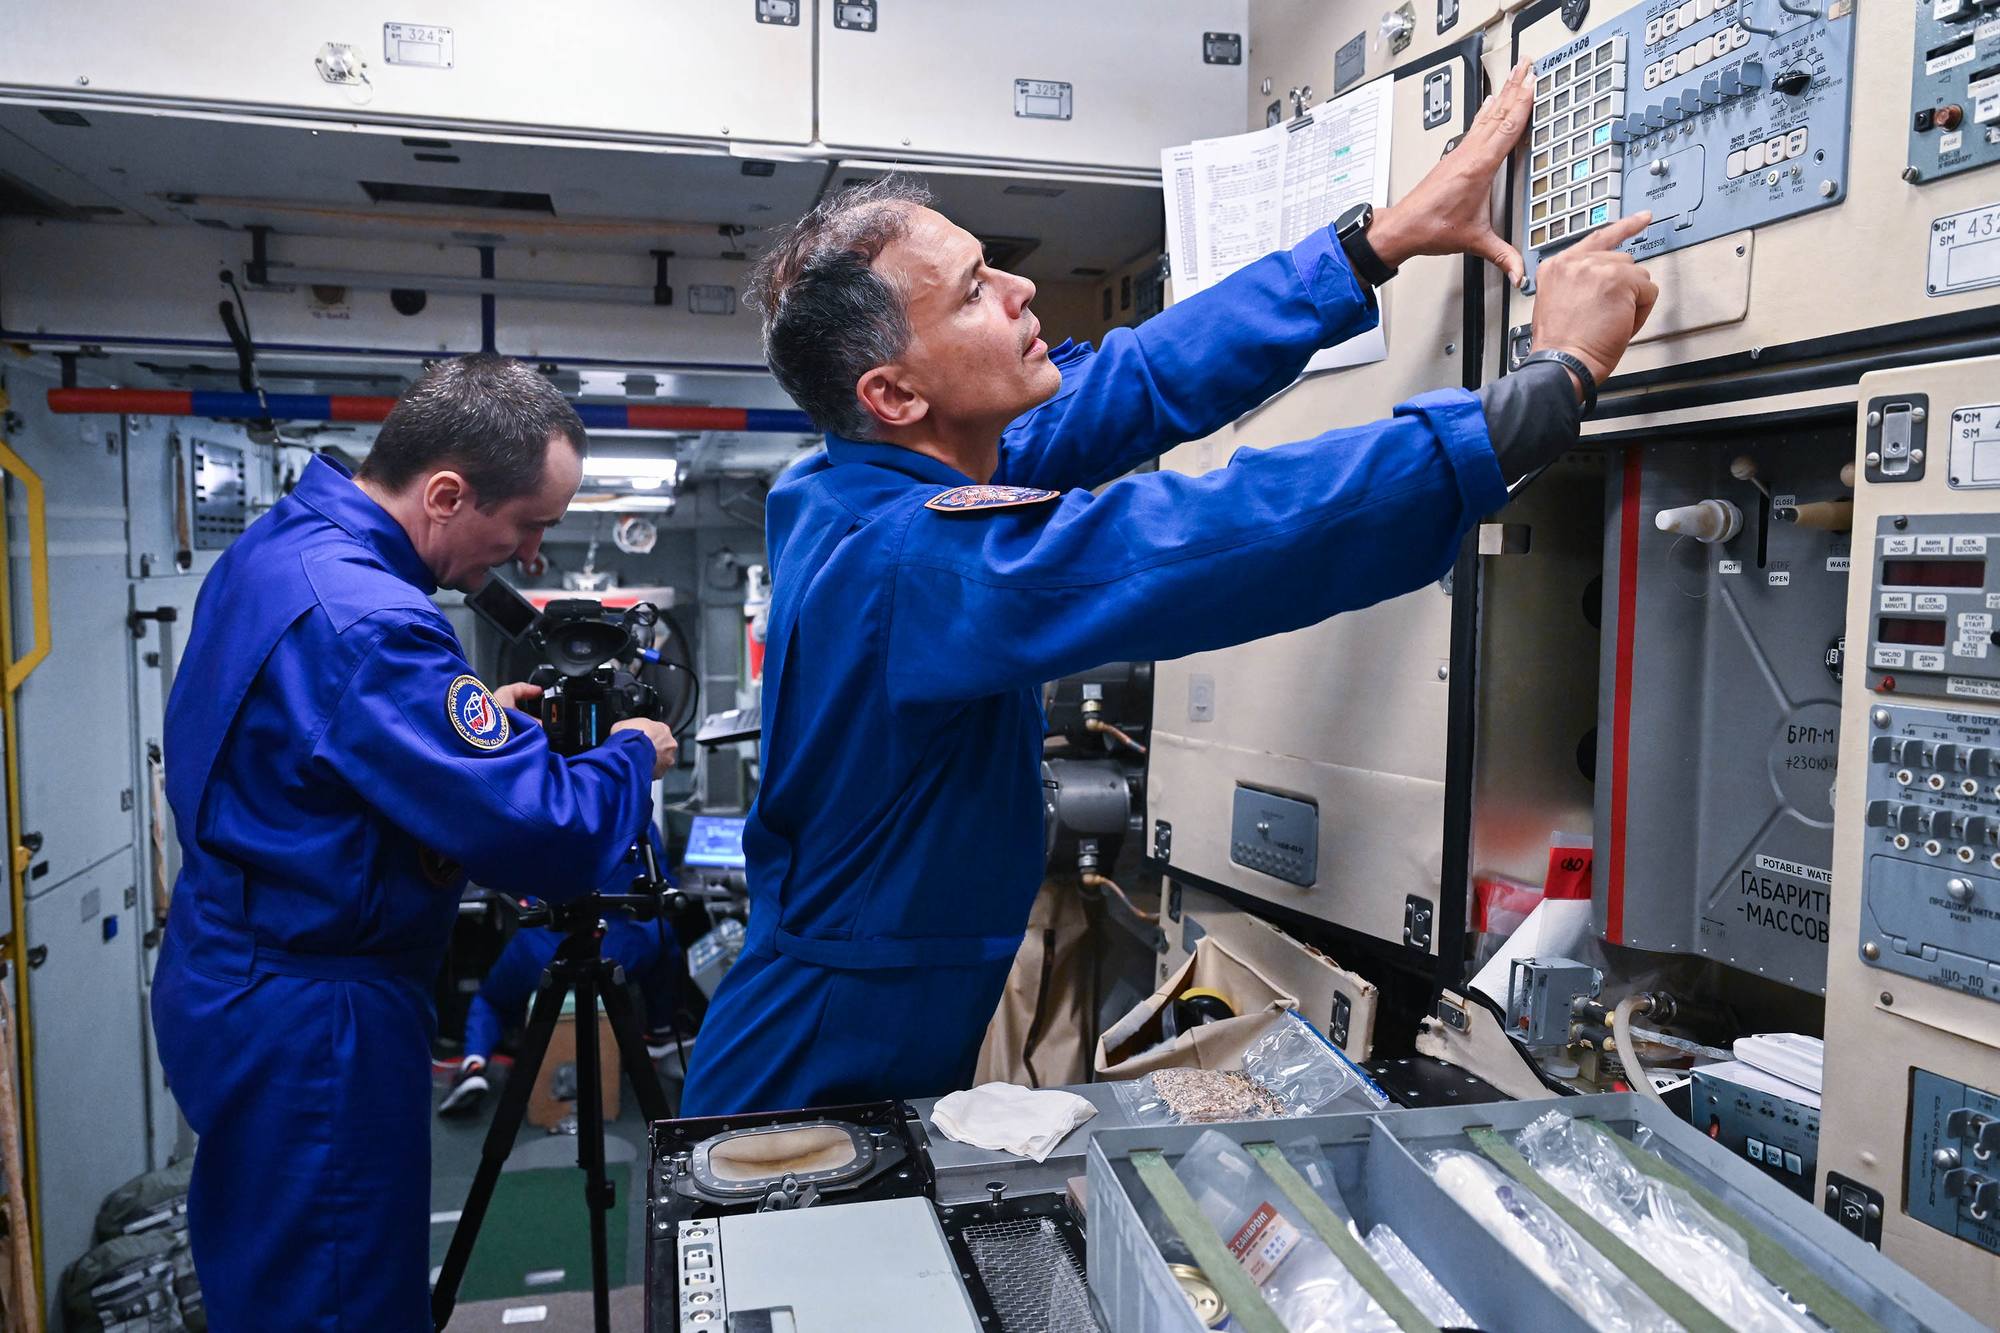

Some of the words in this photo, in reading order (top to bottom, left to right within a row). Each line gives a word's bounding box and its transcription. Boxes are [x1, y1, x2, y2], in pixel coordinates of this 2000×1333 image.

[408, 28, 433, 41] 324
[1940, 235, 1955, 246] SM
[1962, 428, 1980, 439] SM
[1954, 686, 1979, 694] DIGITAL
[1787, 724, 1834, 745] БРП-М
[1763, 858, 1803, 876] POTABLE
[1807, 868, 1832, 883] WATE
